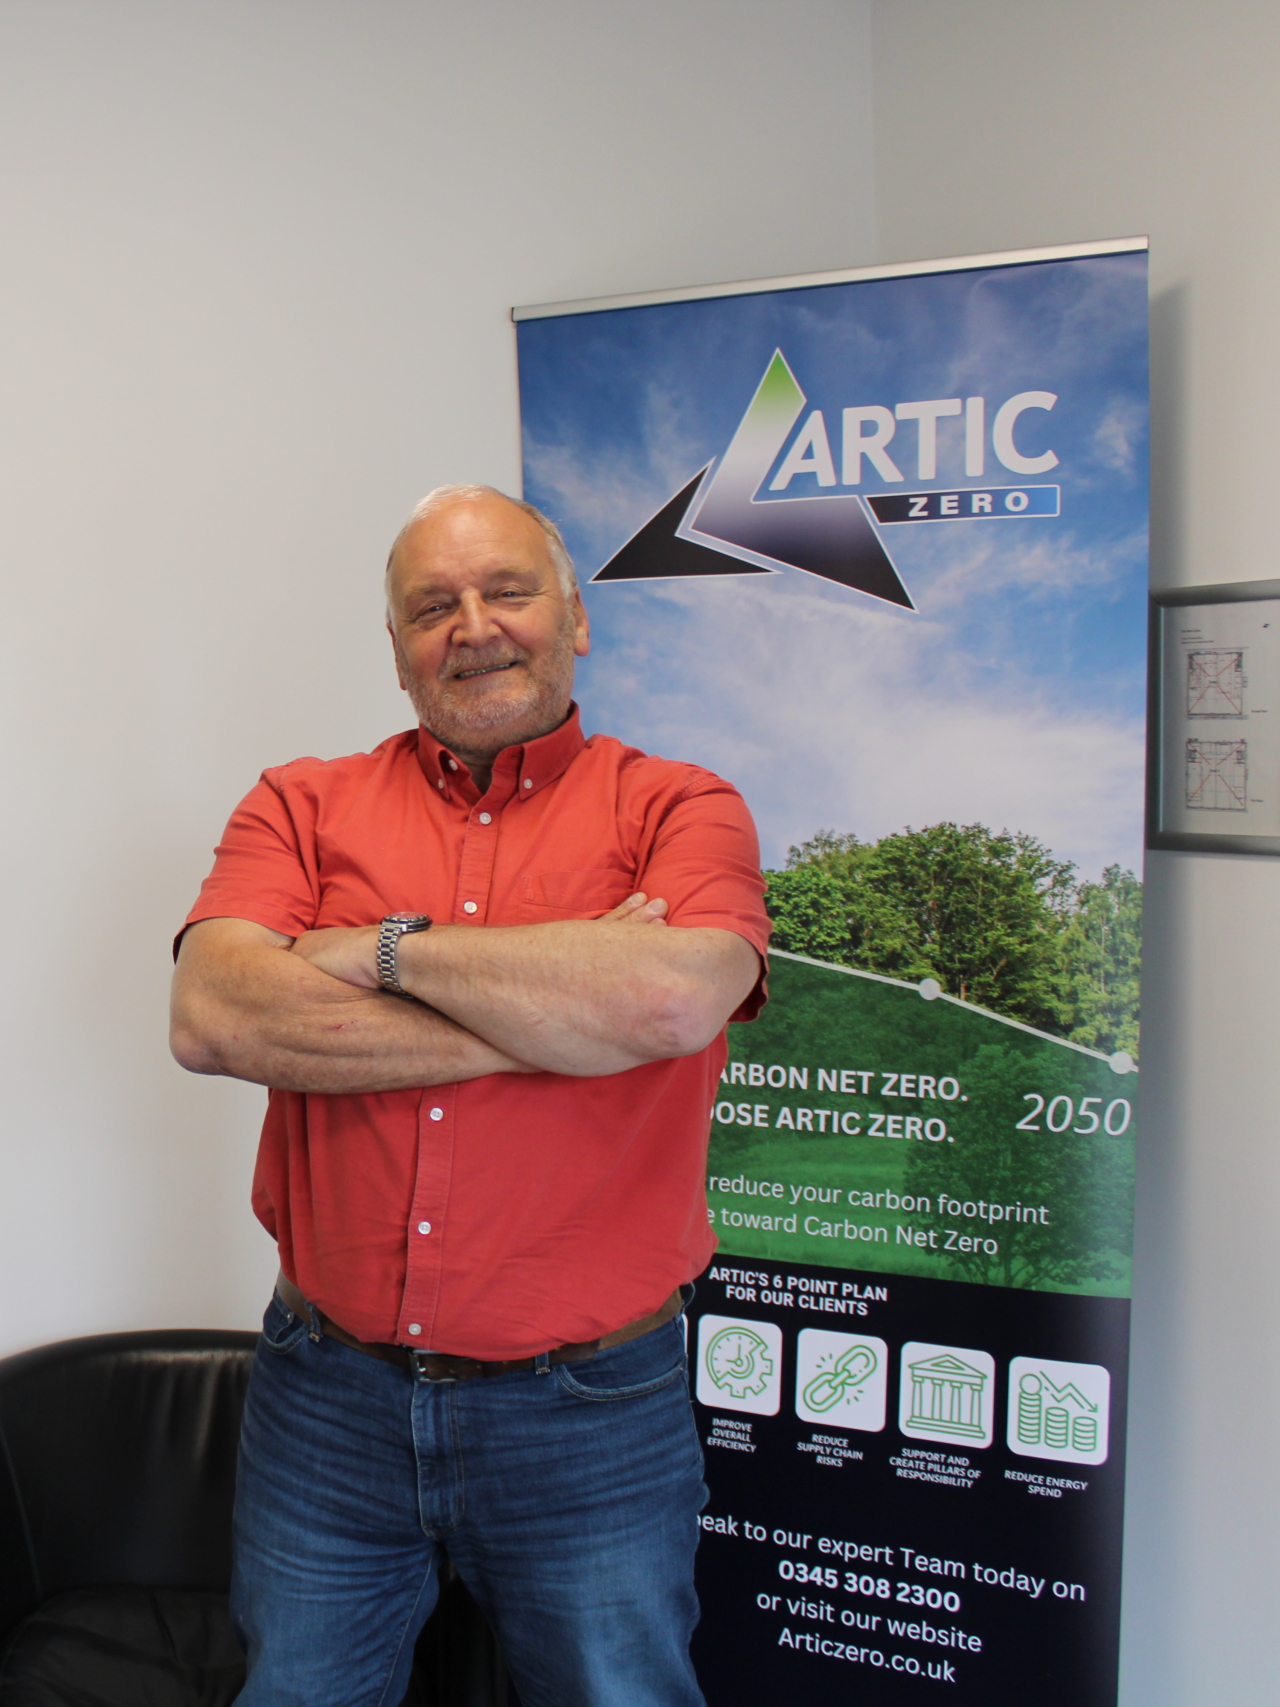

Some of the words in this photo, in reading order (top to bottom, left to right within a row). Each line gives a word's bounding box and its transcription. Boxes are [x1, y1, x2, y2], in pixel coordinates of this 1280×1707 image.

[768, 390, 1060, 491] ARTIC
[908, 491, 1029, 517] ZERO
[817, 1068, 874, 1095] NET
[881, 1072, 969, 1102] ZERO.
[709, 1101, 770, 1128] OSE
[775, 1106, 862, 1136] ARTIC
[867, 1113, 955, 1143] ZERO.
[1015, 1093, 1132, 1136] 2050
[709, 1174, 785, 1198] reduce
[789, 1184, 843, 1205] your
[848, 1187, 930, 1214] carbon
[937, 1194, 1050, 1226] footprint
[721, 1208, 797, 1234] toward
[804, 1216, 888, 1243] Carbon
[896, 1226, 939, 1249] Net
[944, 1230, 999, 1256] Zero
[708, 1267, 769, 1286] ARTIC'S
[773, 1275, 783, 1289] 6
[786, 1276, 838, 1295] POINT
[841, 1283, 888, 1302] PLAN
[725, 1285, 757, 1302] FOR
[760, 1290, 794, 1307] OUR
[798, 1295, 869, 1316] CLIENTS
[712, 1418, 753, 1432] IMPROVE
[712, 1428, 751, 1442] OVERALL
[707, 1437, 757, 1453] EFFICIENCY
[797, 1442, 832, 1455] SUPPLY
[833, 1448, 863, 1460] CHAIN
[811, 1434, 850, 1448] REDUCE
[816, 1455, 843, 1467] RISKS
[889, 1457, 926, 1470] CREATE
[927, 1463, 966, 1477] PILLARS
[967, 1469, 981, 1479] OF
[901, 1448, 947, 1463] SUPPORT
[948, 1455, 969, 1467] AND
[896, 1468, 974, 1488] RESPONSIBILITY
[1004, 1470, 1044, 1485] REDUCE
[1045, 1476, 1088, 1491] ENERGY
[1027, 1484, 1062, 1498] SPEND
[697, 1514, 738, 1536] eak
[743, 1520, 767, 1541] to
[773, 1529, 813, 1549] our
[818, 1535, 894, 1566] expert
[899, 1548, 966, 1579] Team
[972, 1560, 1045, 1598] today
[1052, 1580, 1086, 1601] on
[778, 1560, 838, 1588] 0345
[844, 1574, 890, 1599] 308
[896, 1583, 961, 1612] 2300
[756, 1592, 782, 1611] or
[787, 1594, 834, 1623] visit
[840, 1608, 882, 1632] our
[887, 1617, 982, 1652] website
[778, 1627, 956, 1683] Articzero.co.uk
